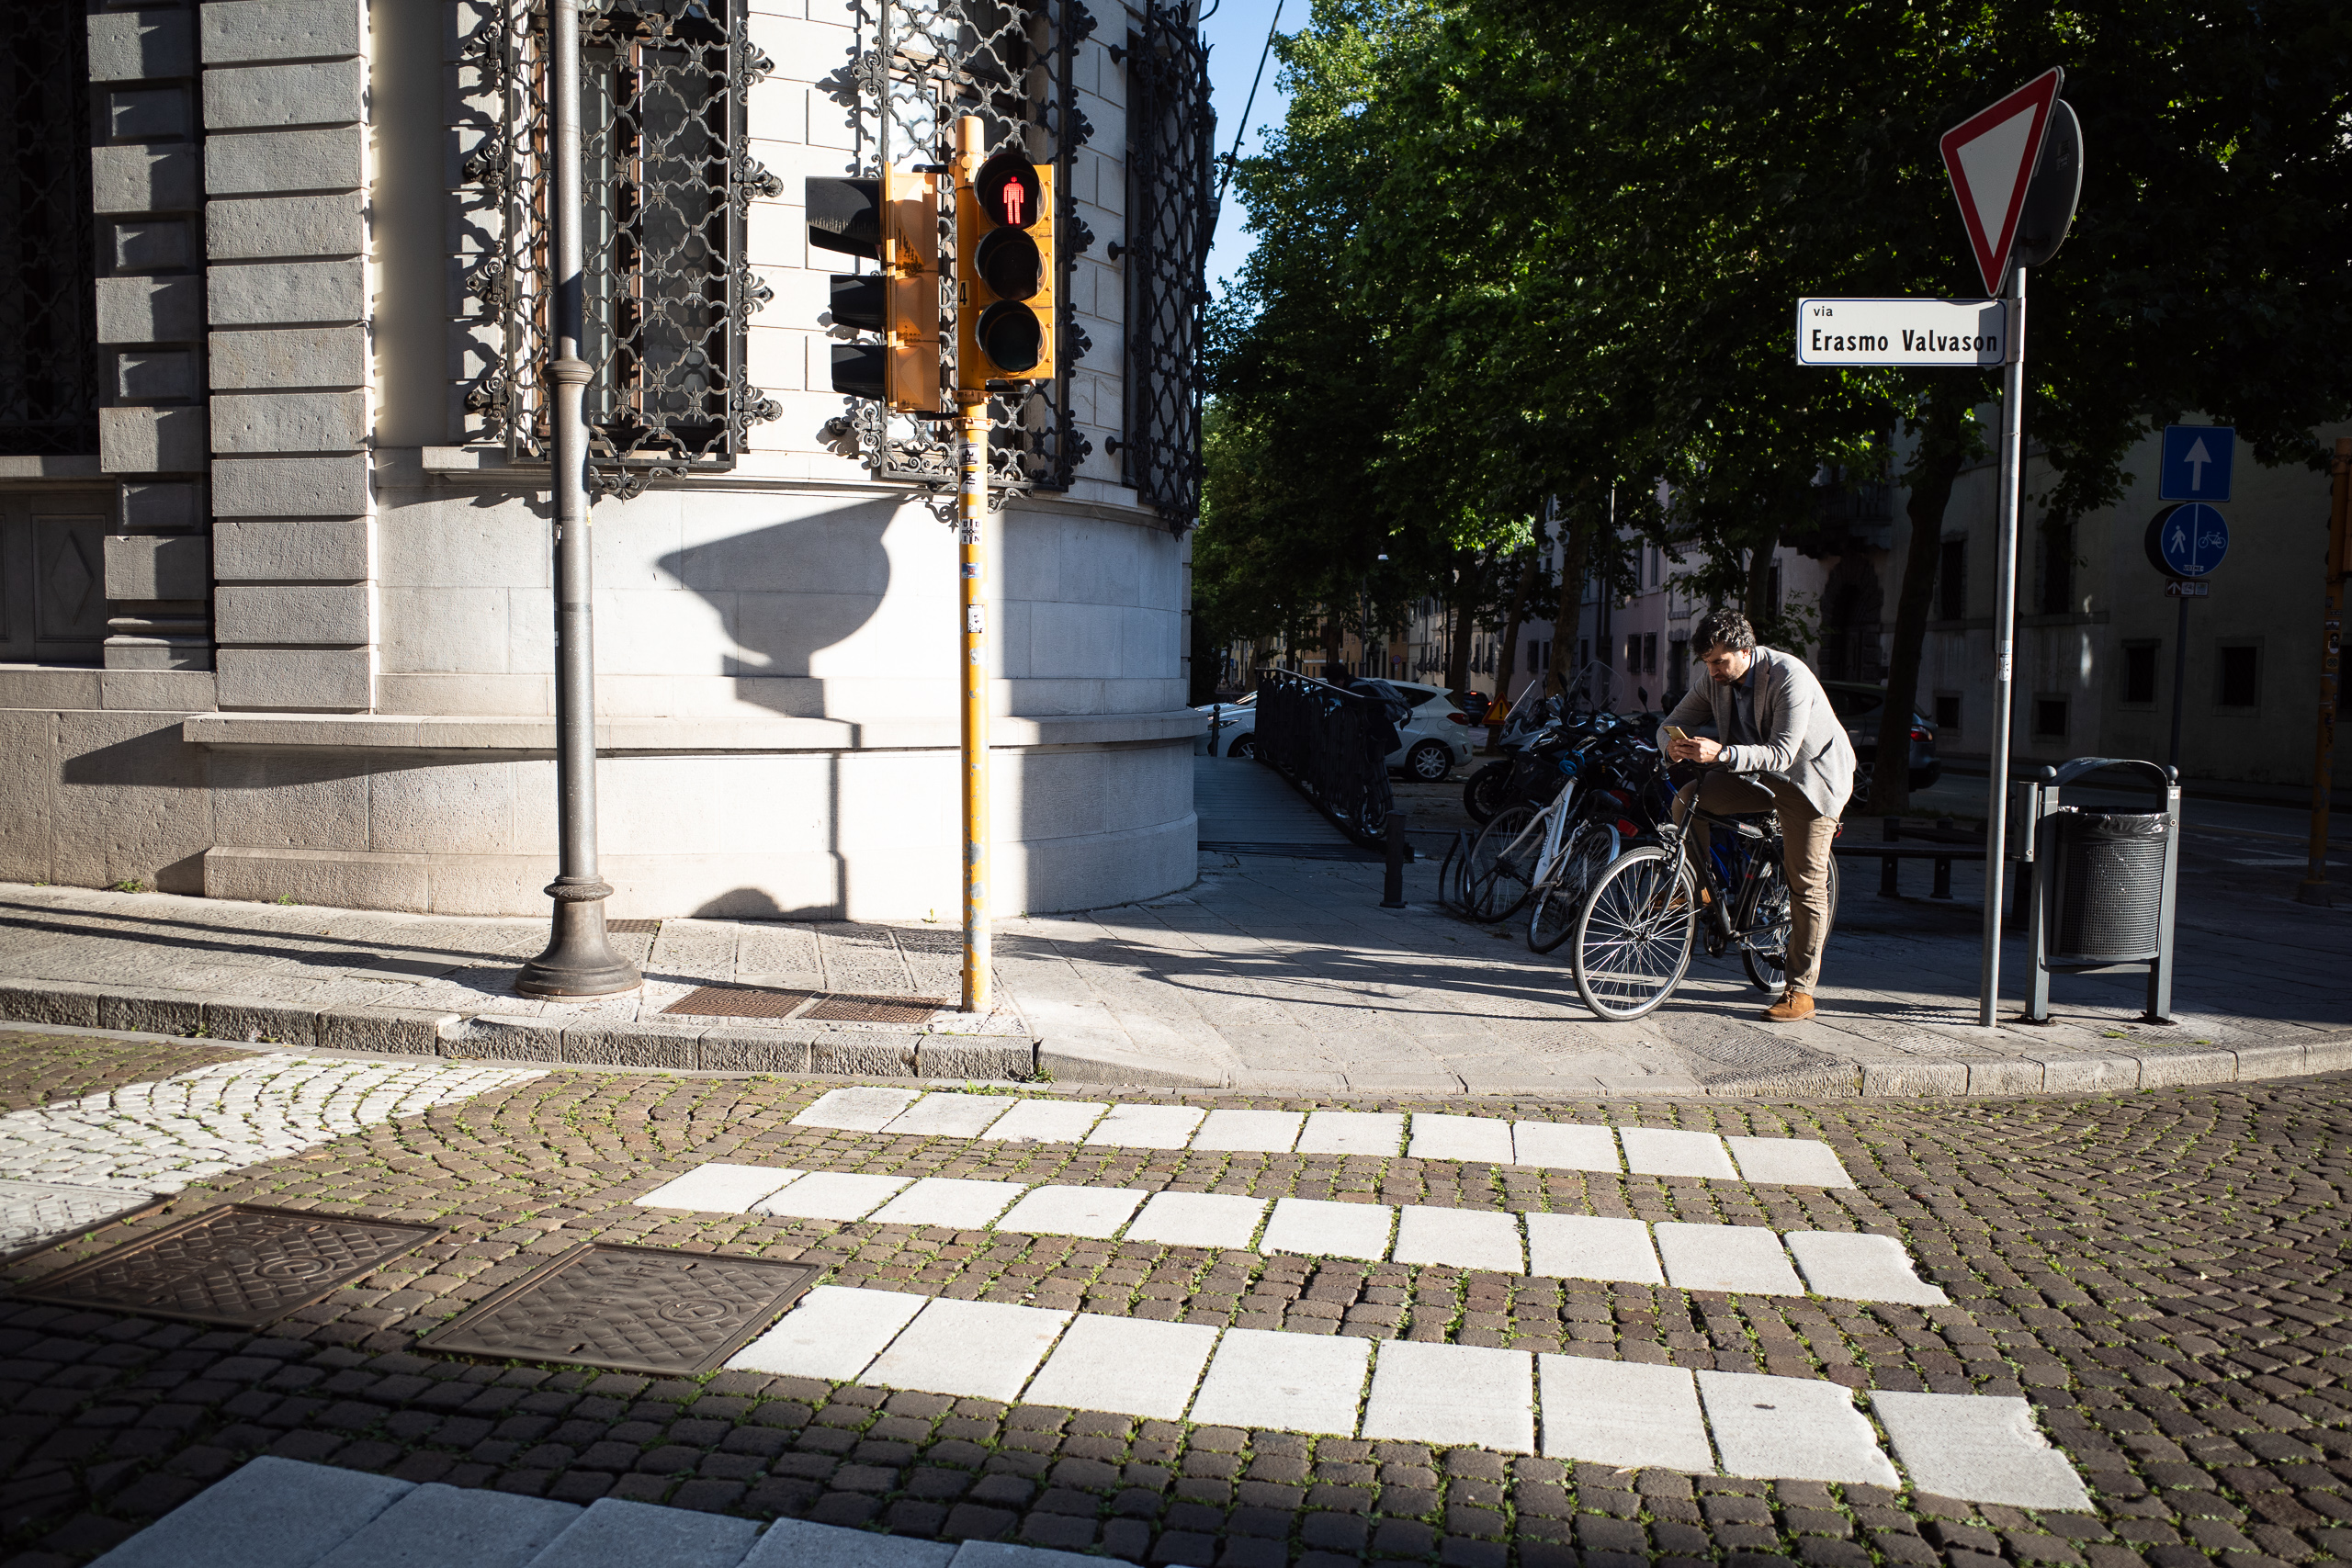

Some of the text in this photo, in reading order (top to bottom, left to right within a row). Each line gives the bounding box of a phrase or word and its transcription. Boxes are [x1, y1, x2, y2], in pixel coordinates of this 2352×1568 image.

[959, 282, 967, 305] 4
[1814, 305, 1834, 317] via
[1812, 329, 1998, 352] Erasmo Valvason
